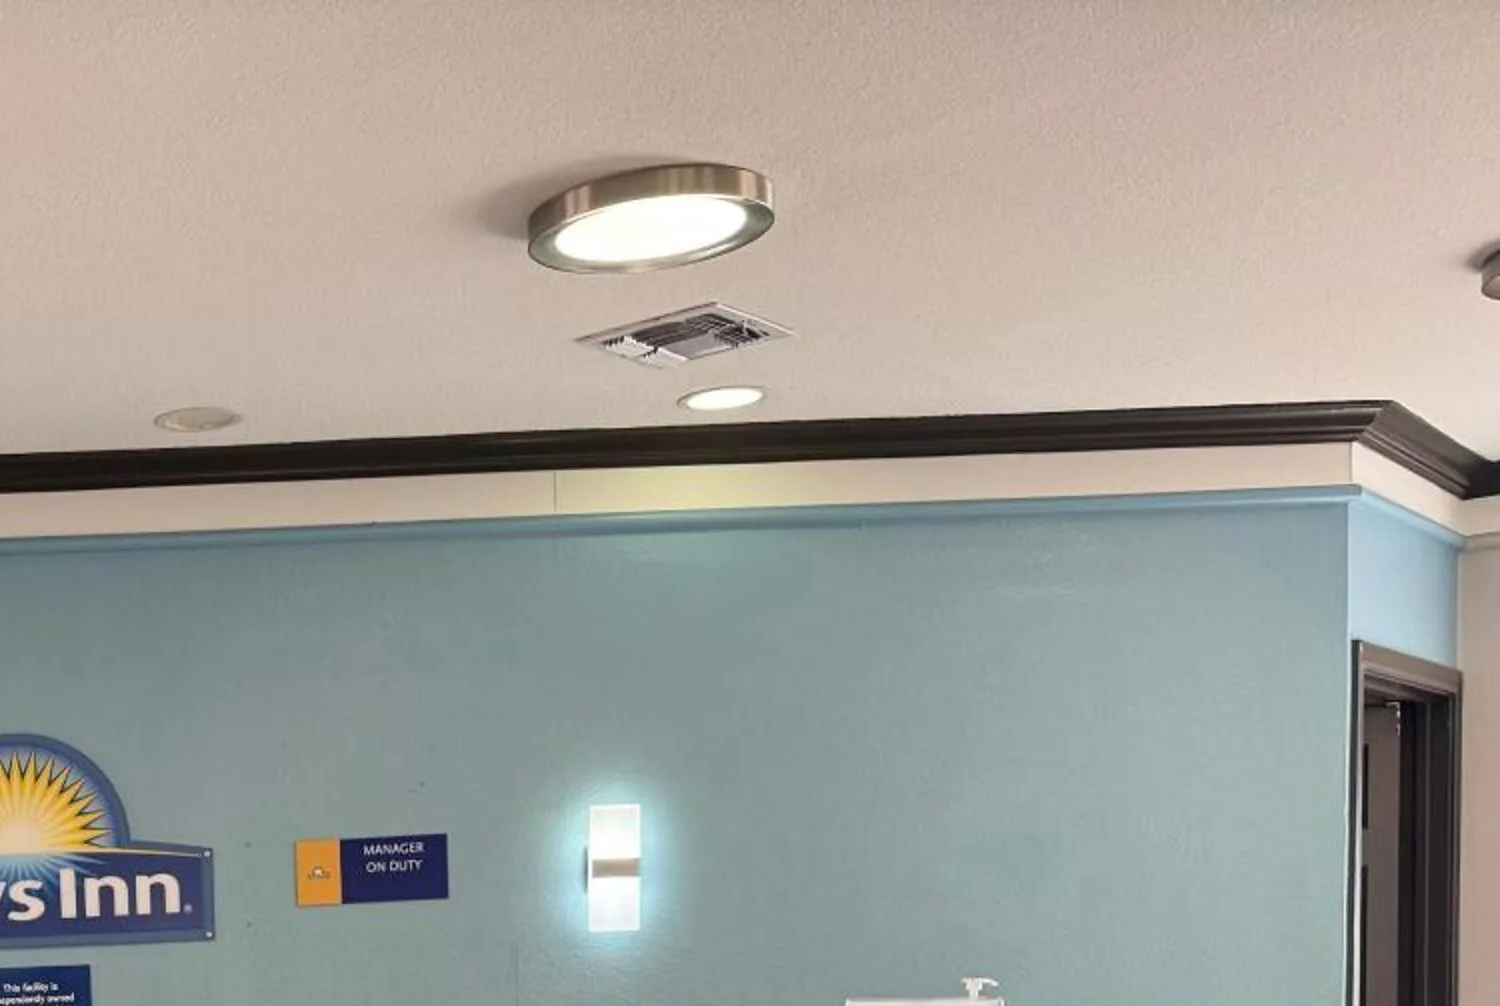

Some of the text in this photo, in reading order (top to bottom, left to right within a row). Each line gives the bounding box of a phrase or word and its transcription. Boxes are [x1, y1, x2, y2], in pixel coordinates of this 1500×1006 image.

[363, 842, 425, 856] MANAGER
[365, 859, 424, 873] ON DUTY
[59, 867, 182, 920] Inn
